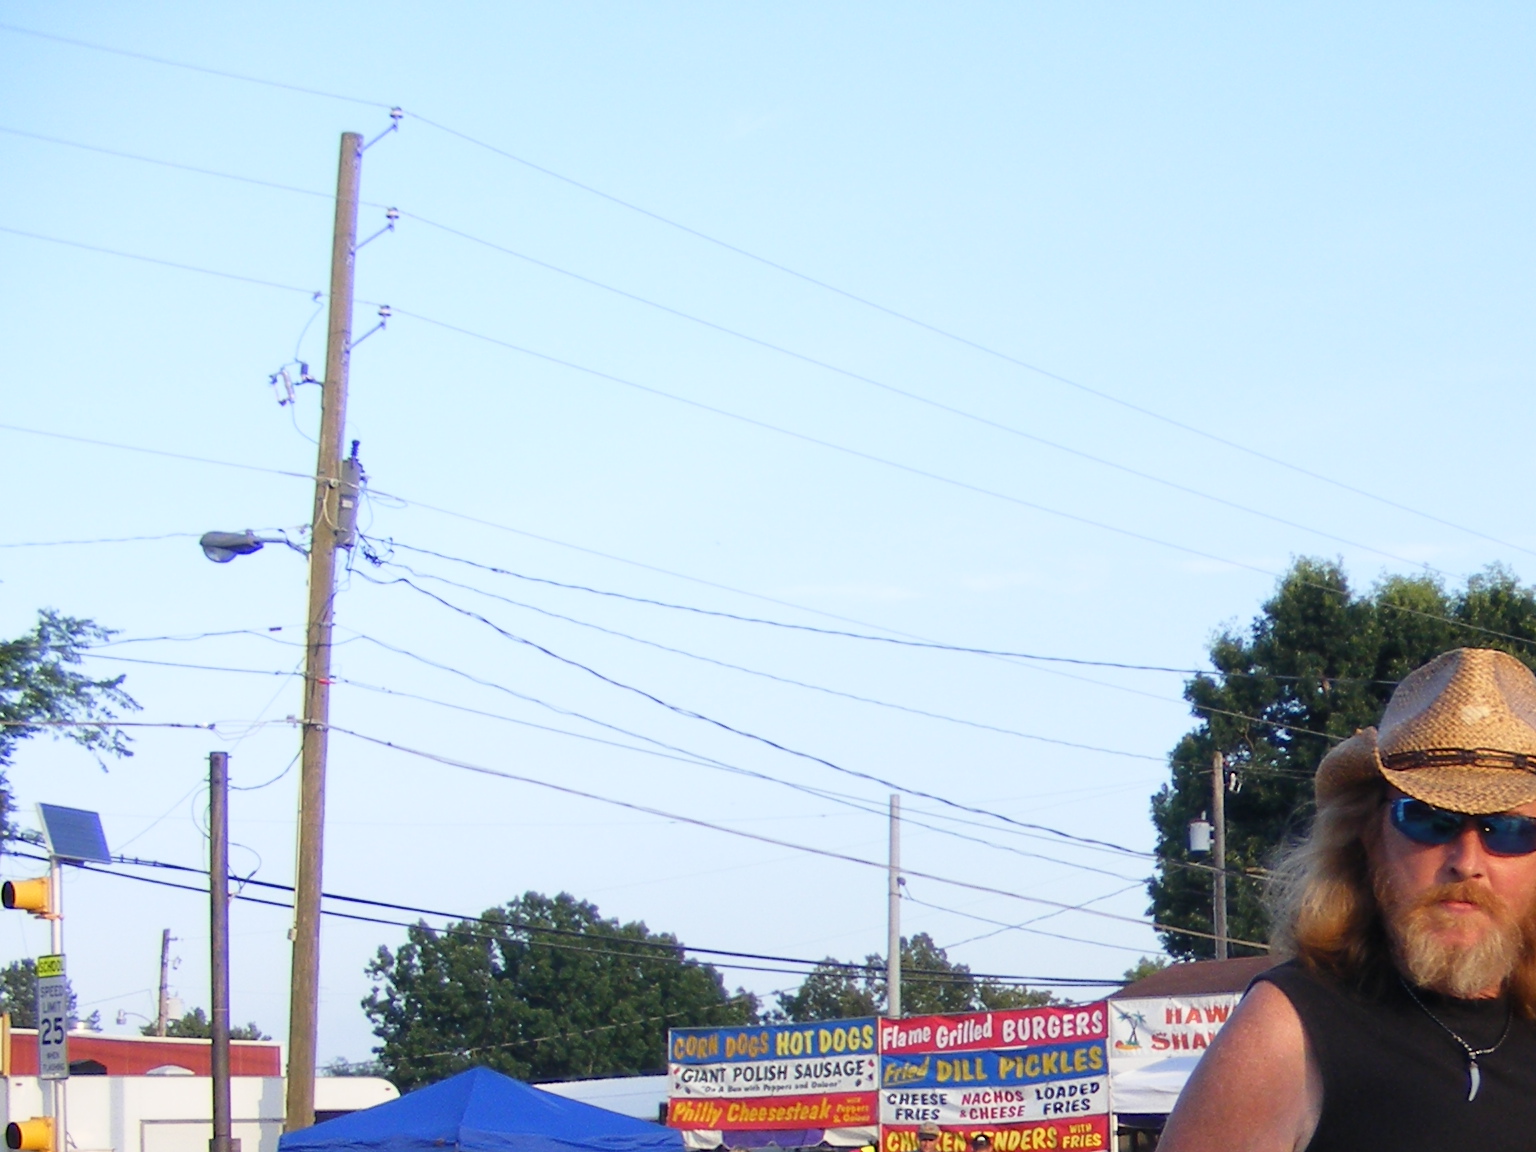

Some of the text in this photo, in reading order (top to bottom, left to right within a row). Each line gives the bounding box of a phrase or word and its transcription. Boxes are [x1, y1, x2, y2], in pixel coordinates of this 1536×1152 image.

[39, 960, 65, 973] SCHOOL
[41, 985, 63, 997] SPEED
[43, 1001, 61, 1013] LIMIT
[1166, 1004, 1236, 1025] HAW
[42, 1017, 64, 1045] 25
[882, 1010, 1104, 1050] Flame Grilled BURGERS
[674, 1025, 874, 1060] CORN DOGS HOT DOGS
[681, 1059, 866, 1084] GIANT POLISH SAUSAGE
[883, 1045, 1104, 1085] Fried DILL PICKLES
[763, 1084, 792, 1095] Peppers
[794, 1082, 808, 1090] and
[961, 1089, 1025, 1106] NACHOS
[1035, 1082, 1100, 1101] LOADED
[887, 1092, 948, 1106] CHEESE
[1043, 1098, 1091, 1116] FRIES
[672, 1097, 832, 1128] Philly Cheesesteak
[895, 1108, 941, 1121] FRIES
[1069, 1122, 1093, 1133] WITH
[886, 1126, 1059, 1152] CHIEN NDERS
[1062, 1132, 1102, 1150] FRIES
